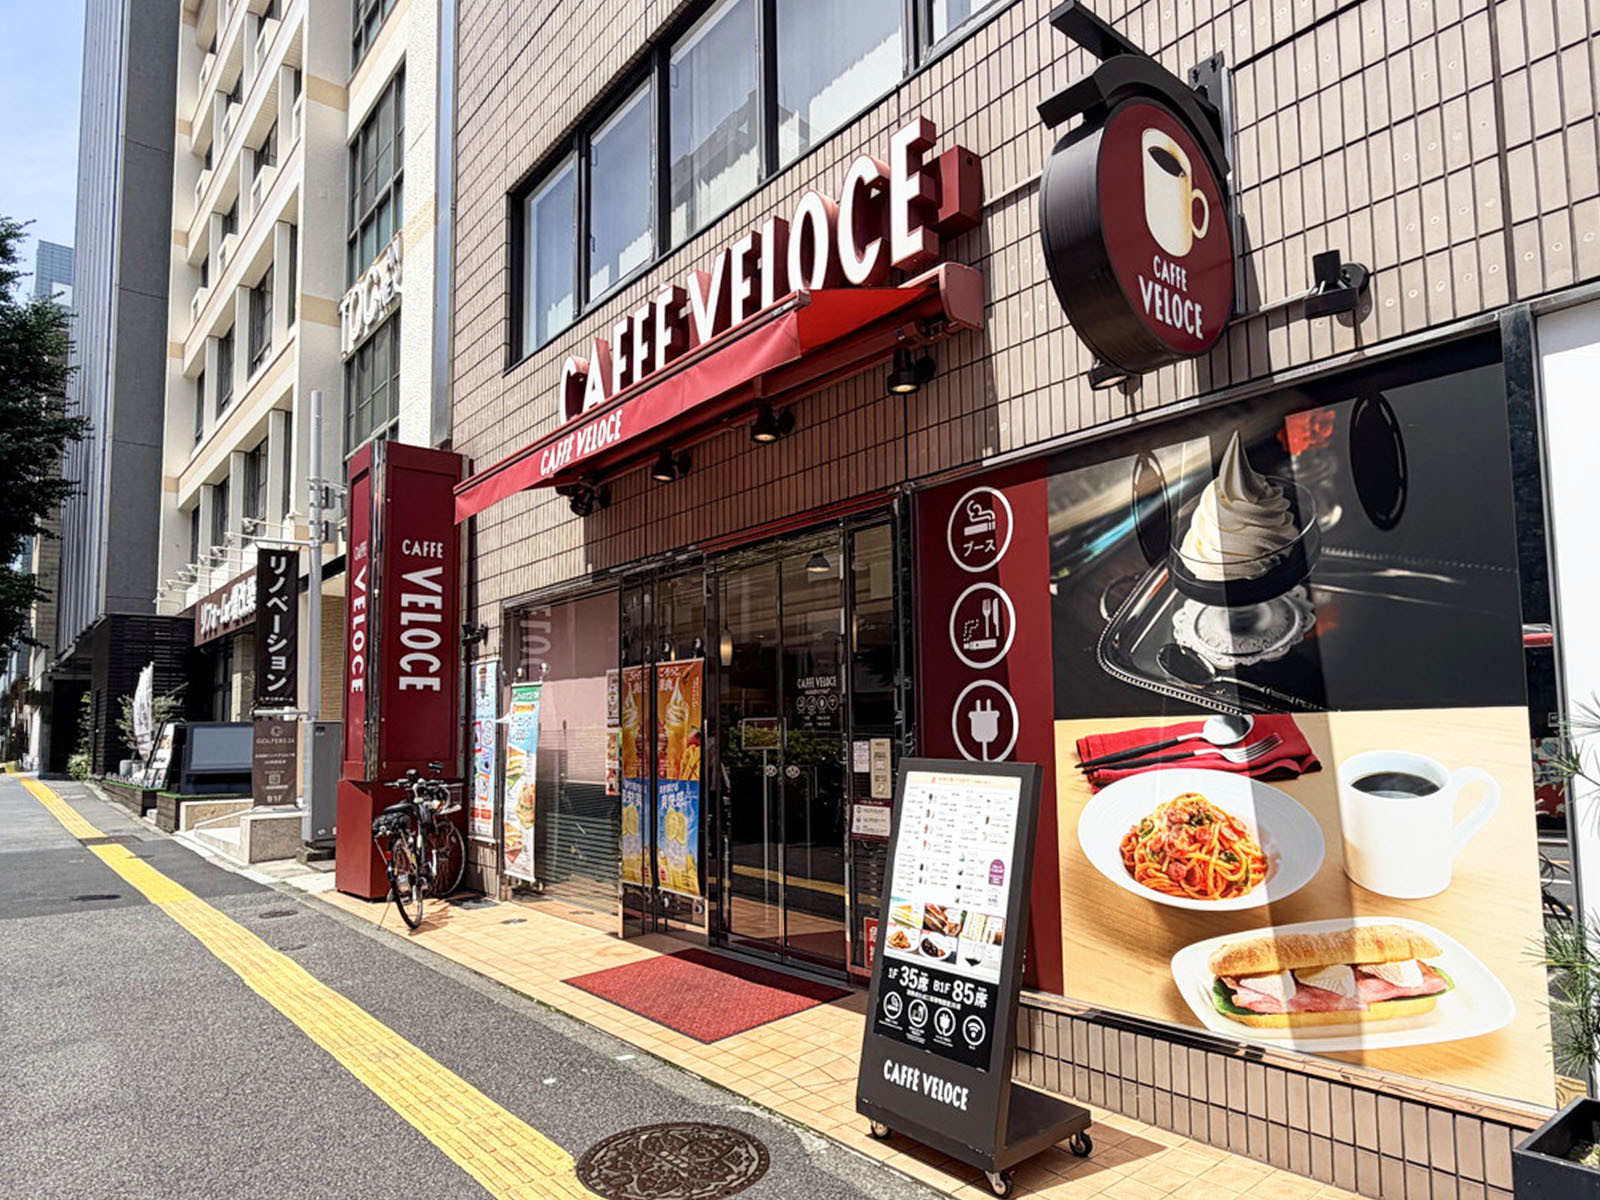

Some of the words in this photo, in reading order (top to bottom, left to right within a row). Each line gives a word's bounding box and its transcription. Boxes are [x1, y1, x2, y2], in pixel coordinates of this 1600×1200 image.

[1153, 255, 1187, 292] CAFFE
[1138, 274, 1204, 340] VELOCE
[576, 409, 623, 457] VELOCE
[402, 539, 443, 559] CAFFE
[963, 539, 996, 557] ブース
[266, 556, 288, 692] リノベーション
[351, 564, 367, 694] VELOCE
[399, 566, 443, 692] VELOCE
[888, 967, 899, 979] 1F
[933, 980, 951, 994] B1F
[922, 1072, 969, 1111] VELOCE
